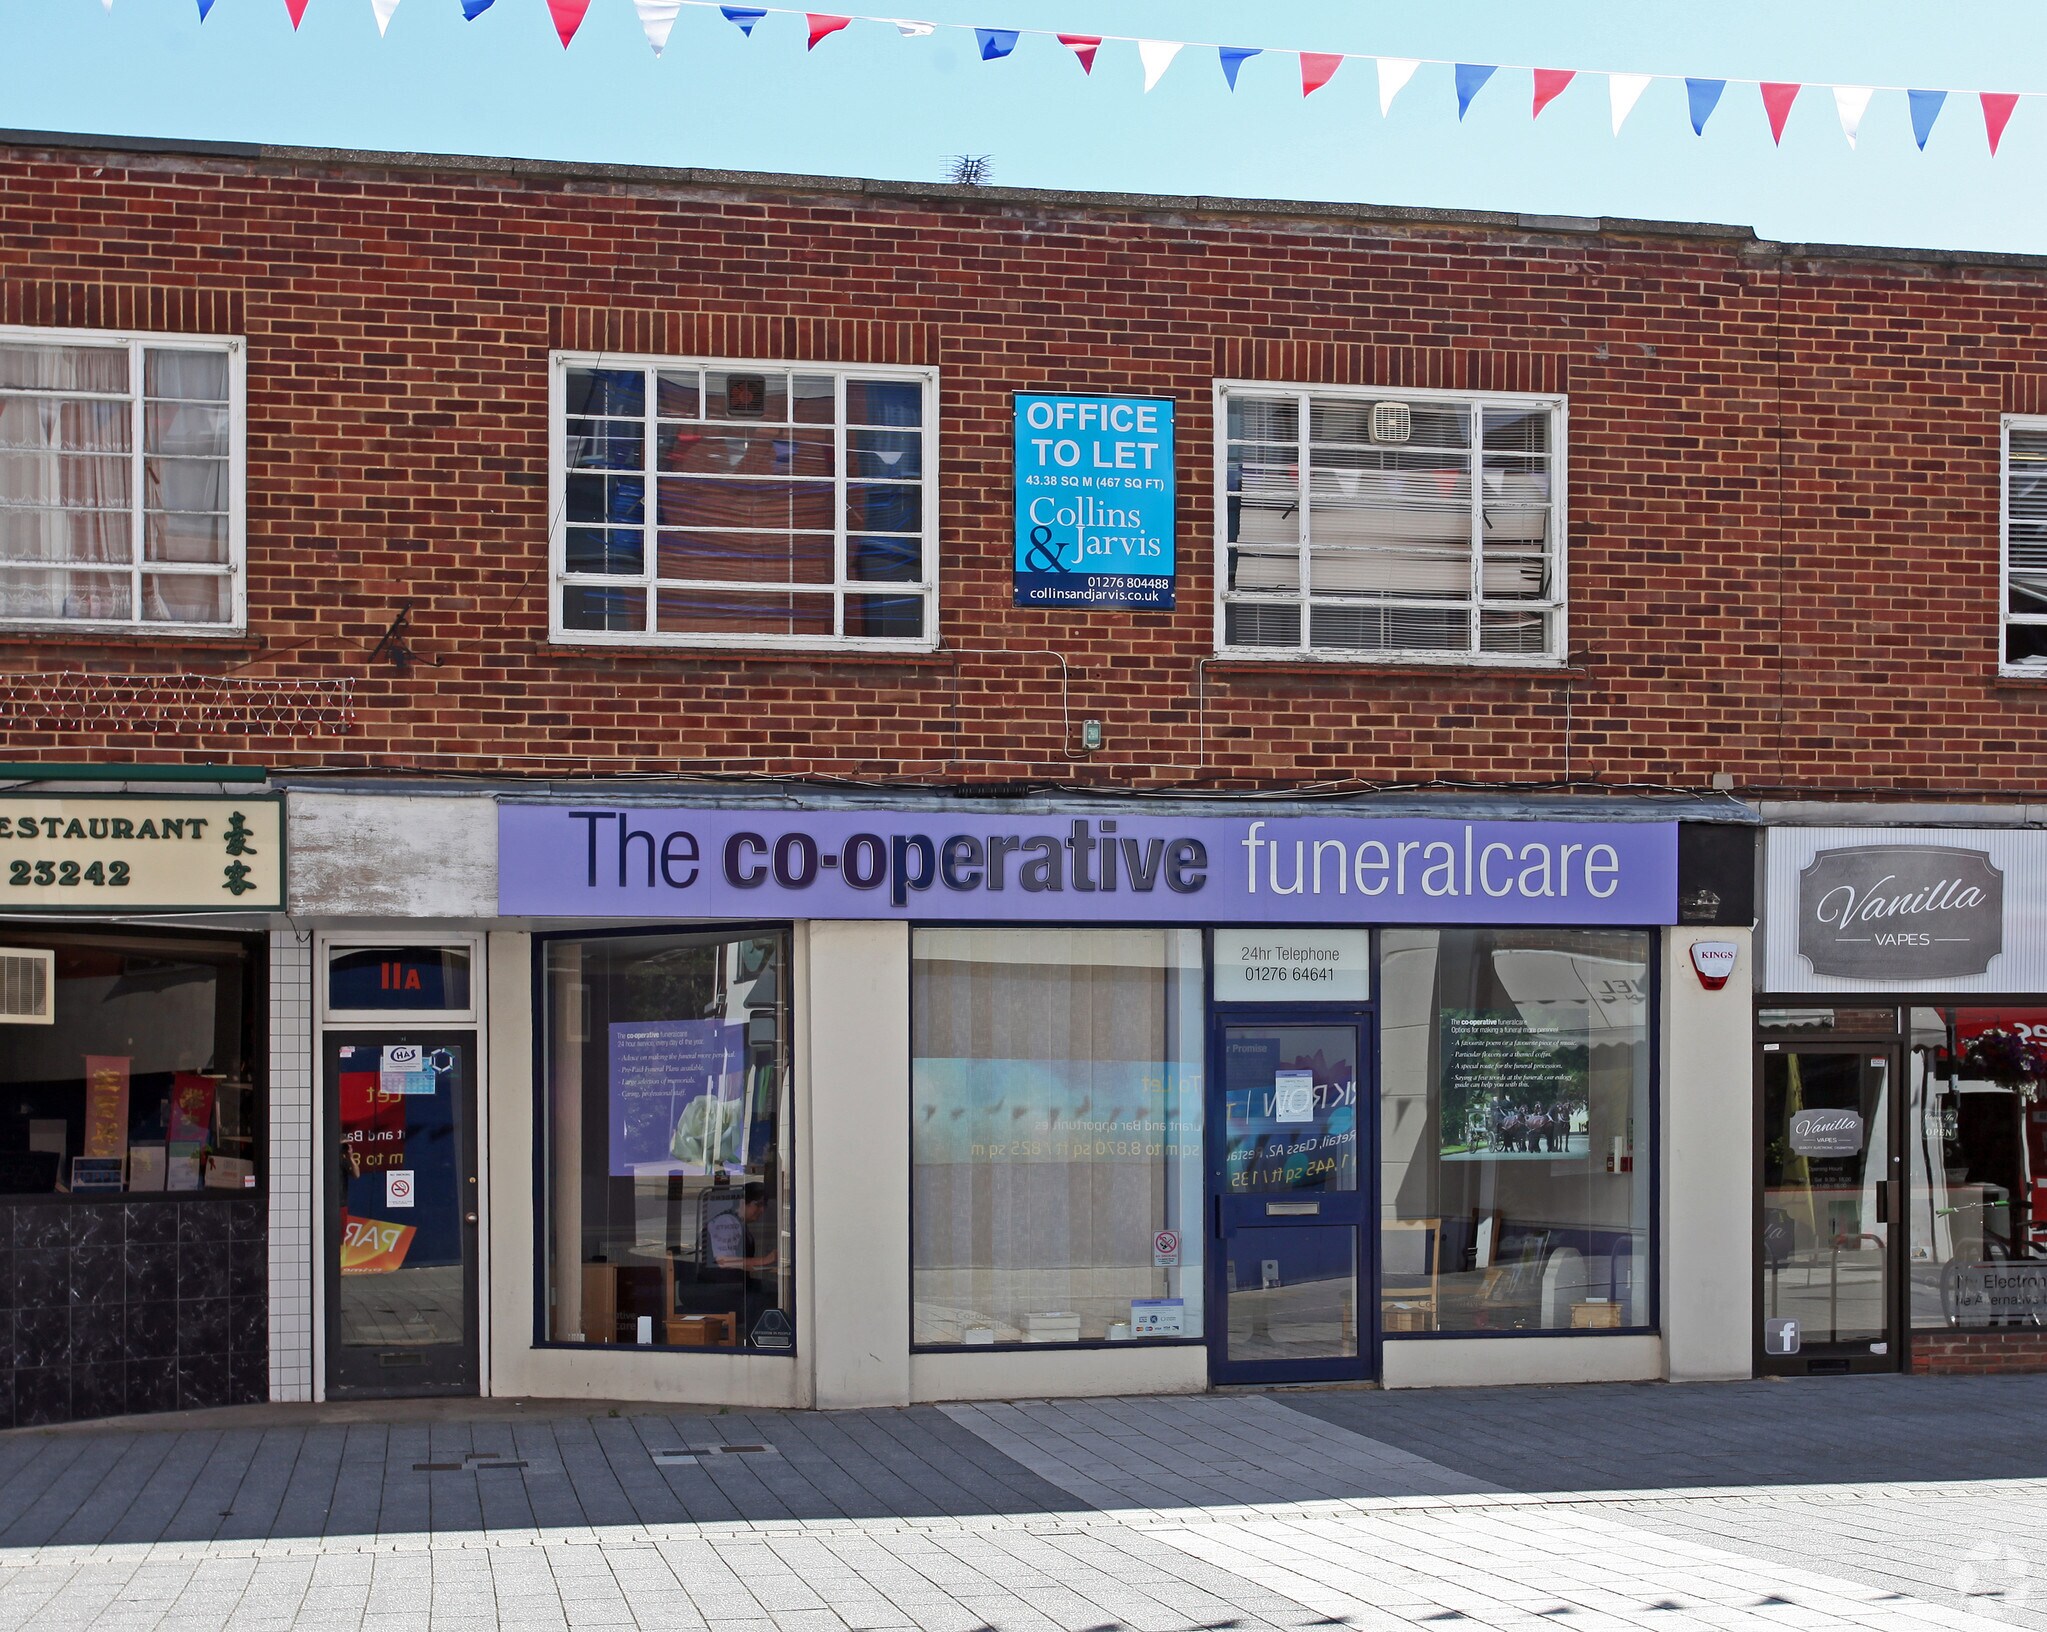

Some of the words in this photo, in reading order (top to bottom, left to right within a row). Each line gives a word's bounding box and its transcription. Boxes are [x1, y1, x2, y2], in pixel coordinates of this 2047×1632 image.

[1027, 402, 1158, 433] OFFICE
[1032, 439, 1080, 467] TO
[1094, 441, 1158, 469] LET
[1026, 476, 1057, 486] 43.38
[1061, 477, 1080, 488] SQ
[1082, 478, 1092, 487] M
[1096, 478, 1120, 490] (467
[1125, 479, 1142, 490] SQ
[1146, 480, 1165, 492] FT)
[1030, 496, 1141, 528] Collins
[1025, 526, 1071, 573] &
[1071, 525, 1160, 564] Jarvis
[1088, 577, 1124, 588] 01276
[1126, 578, 1169, 590] 804488
[1030, 588, 1159, 602] collinsandjarvis.co.uk
[568, 811, 700, 889] The
[722, 819, 1208, 906] co-operative
[1241, 821, 1619, 898] funeralcare
[9, 860, 131, 886] 23242
[1816, 875, 1986, 930] Vanilla
[1875, 934, 1930, 946] VAPES
[1241, 946, 1272, 960] 24hr
[1275, 946, 1340, 963] Telephone
[1702, 951, 1734, 959] KINGS
[1245, 966, 1287, 981] 01276
[1292, 967, 1334, 981] 64641
[1461, 1018, 1498, 1026] co-operative
[1450, 1026, 1471, 1034] Options
[1480, 1026, 1499, 1034] making
[390, 1046, 416, 1062] CHAS
[1232, 1044, 1268, 1053] Promise
[678, 1052, 697, 1060] funeral
[665, 1064, 680, 1072] Plans
[1460, 1062, 1480, 1070] special
[1494, 1062, 1504, 1070] for
[1514, 1062, 1532, 1070] funeral
[622, 1078, 636, 1086] Large
[1454, 1074, 1472, 1082] Saying
[1554, 1074, 1572, 1082] eulogy
[1795, 1116, 1858, 1137] Vanilla
[1926, 1128, 1952, 1136] OPEN
